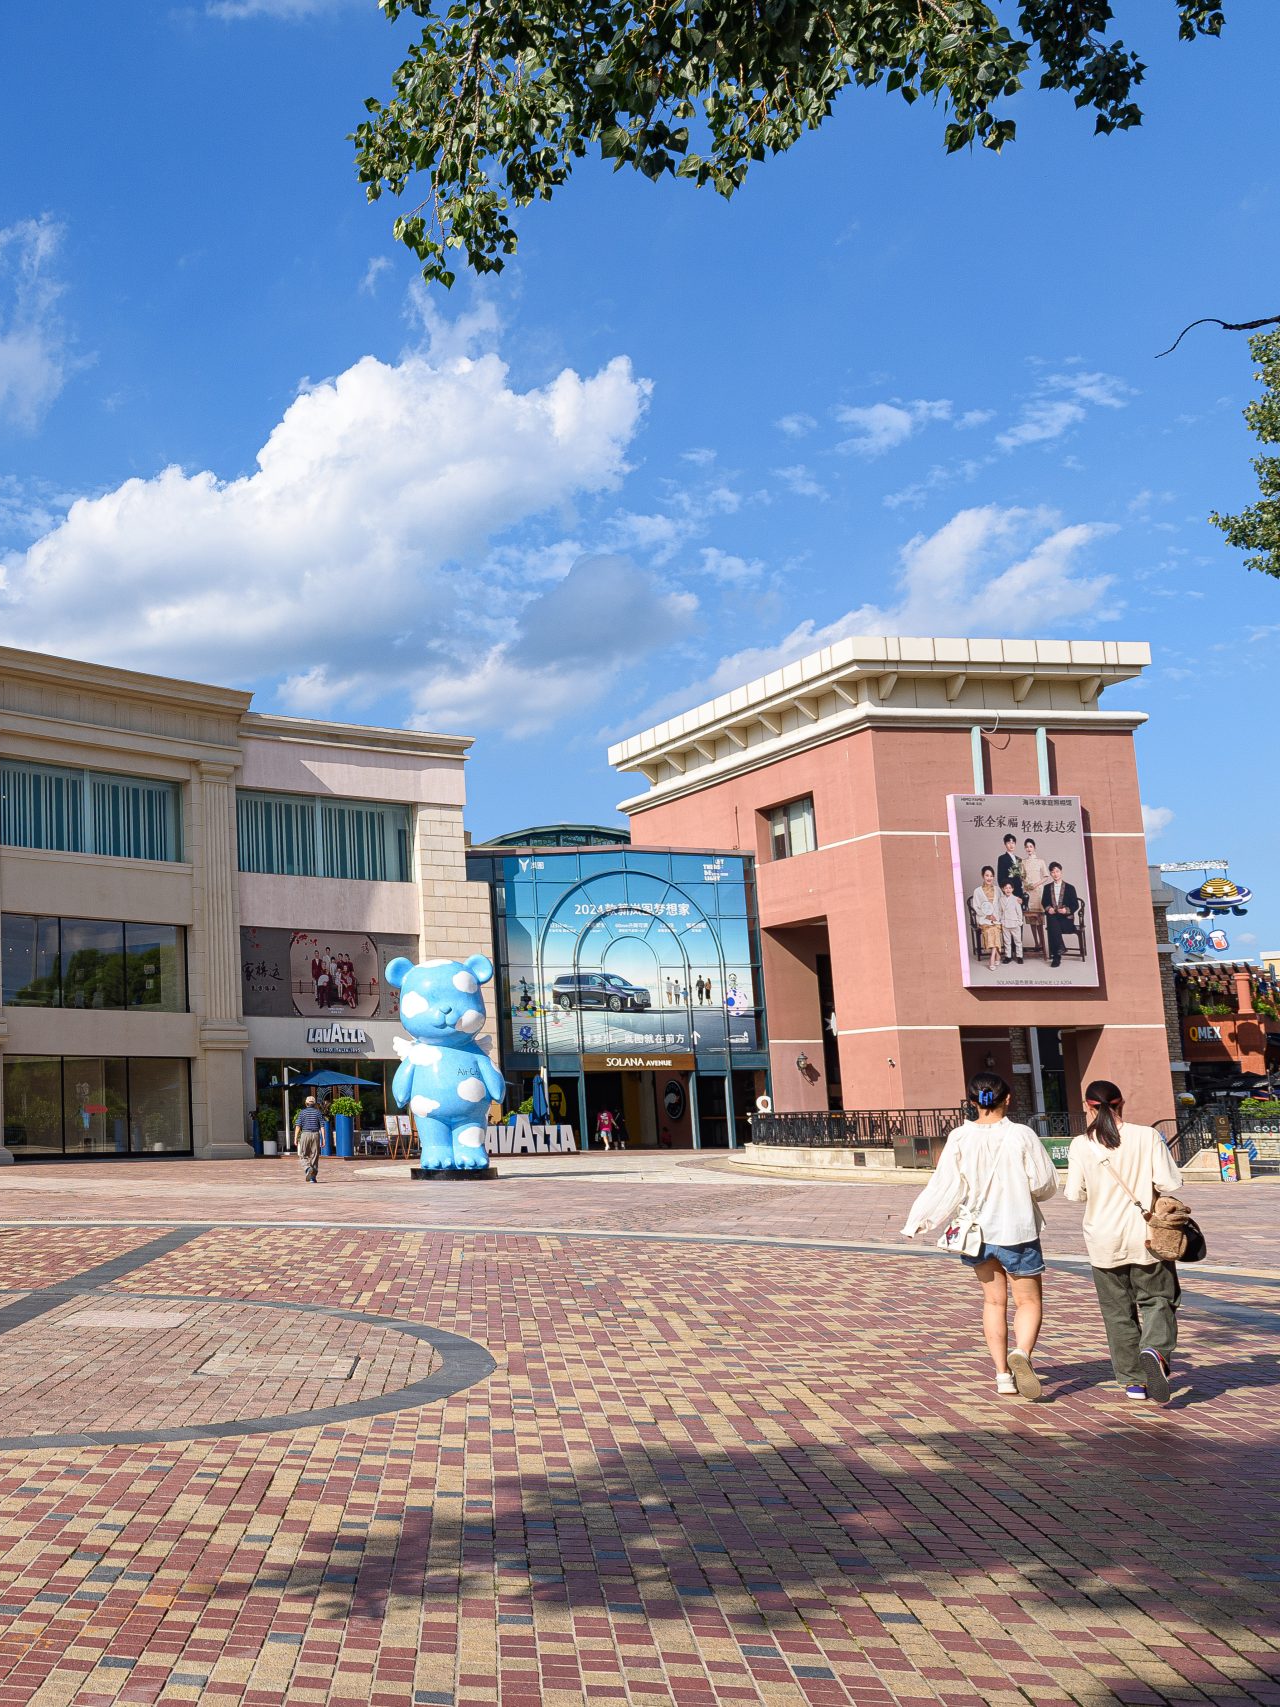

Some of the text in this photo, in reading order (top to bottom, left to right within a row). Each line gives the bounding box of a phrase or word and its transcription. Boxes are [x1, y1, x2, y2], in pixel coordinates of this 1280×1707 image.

[962, 815, 1077, 833] 一张全家福 轻松表达爱
[307, 1023, 367, 1043] LAVAZZA
[1189, 1027, 1222, 1041] QMEX
[606, 1058, 644, 1067] SOLANA
[485, 1114, 577, 1153] AVAZZA
